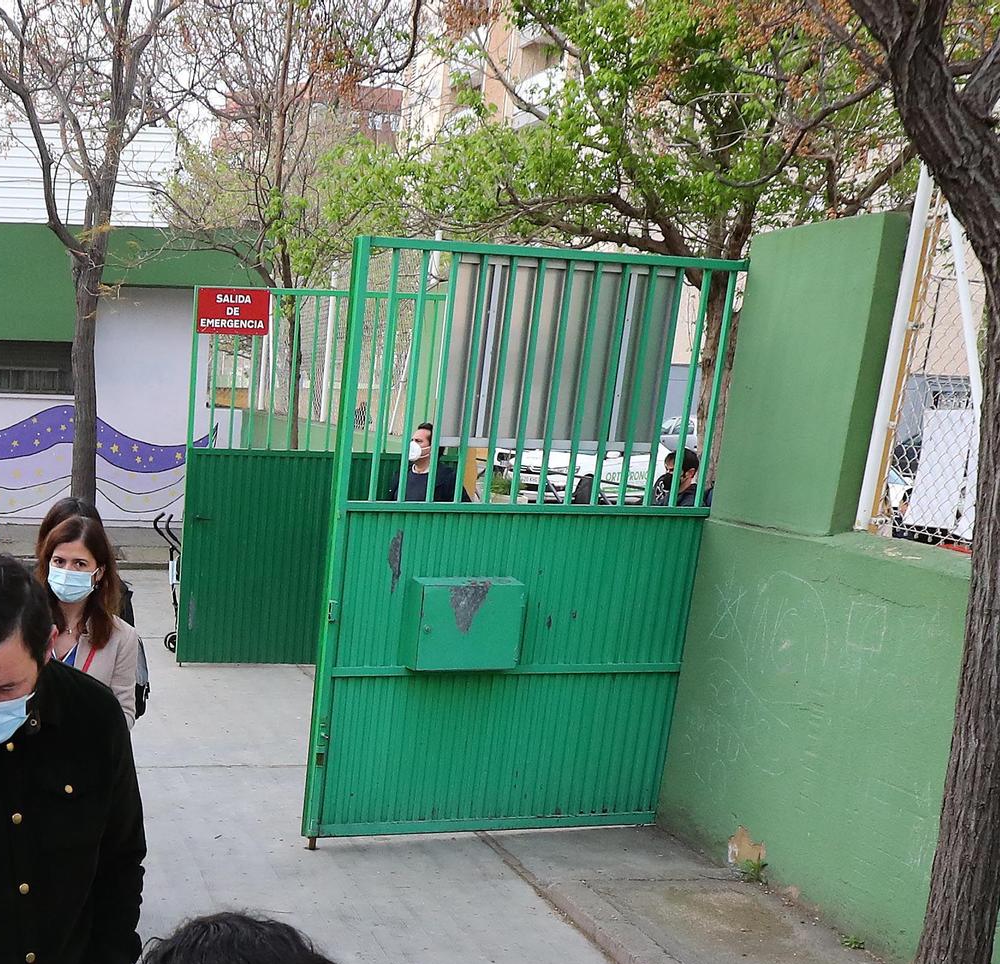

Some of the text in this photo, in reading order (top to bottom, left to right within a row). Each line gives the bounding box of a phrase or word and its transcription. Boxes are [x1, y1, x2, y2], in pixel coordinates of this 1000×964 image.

[215, 293, 252, 304] SALIDA
[226, 306, 240, 316] DE
[199, 318, 265, 329] EMERGENCIA
